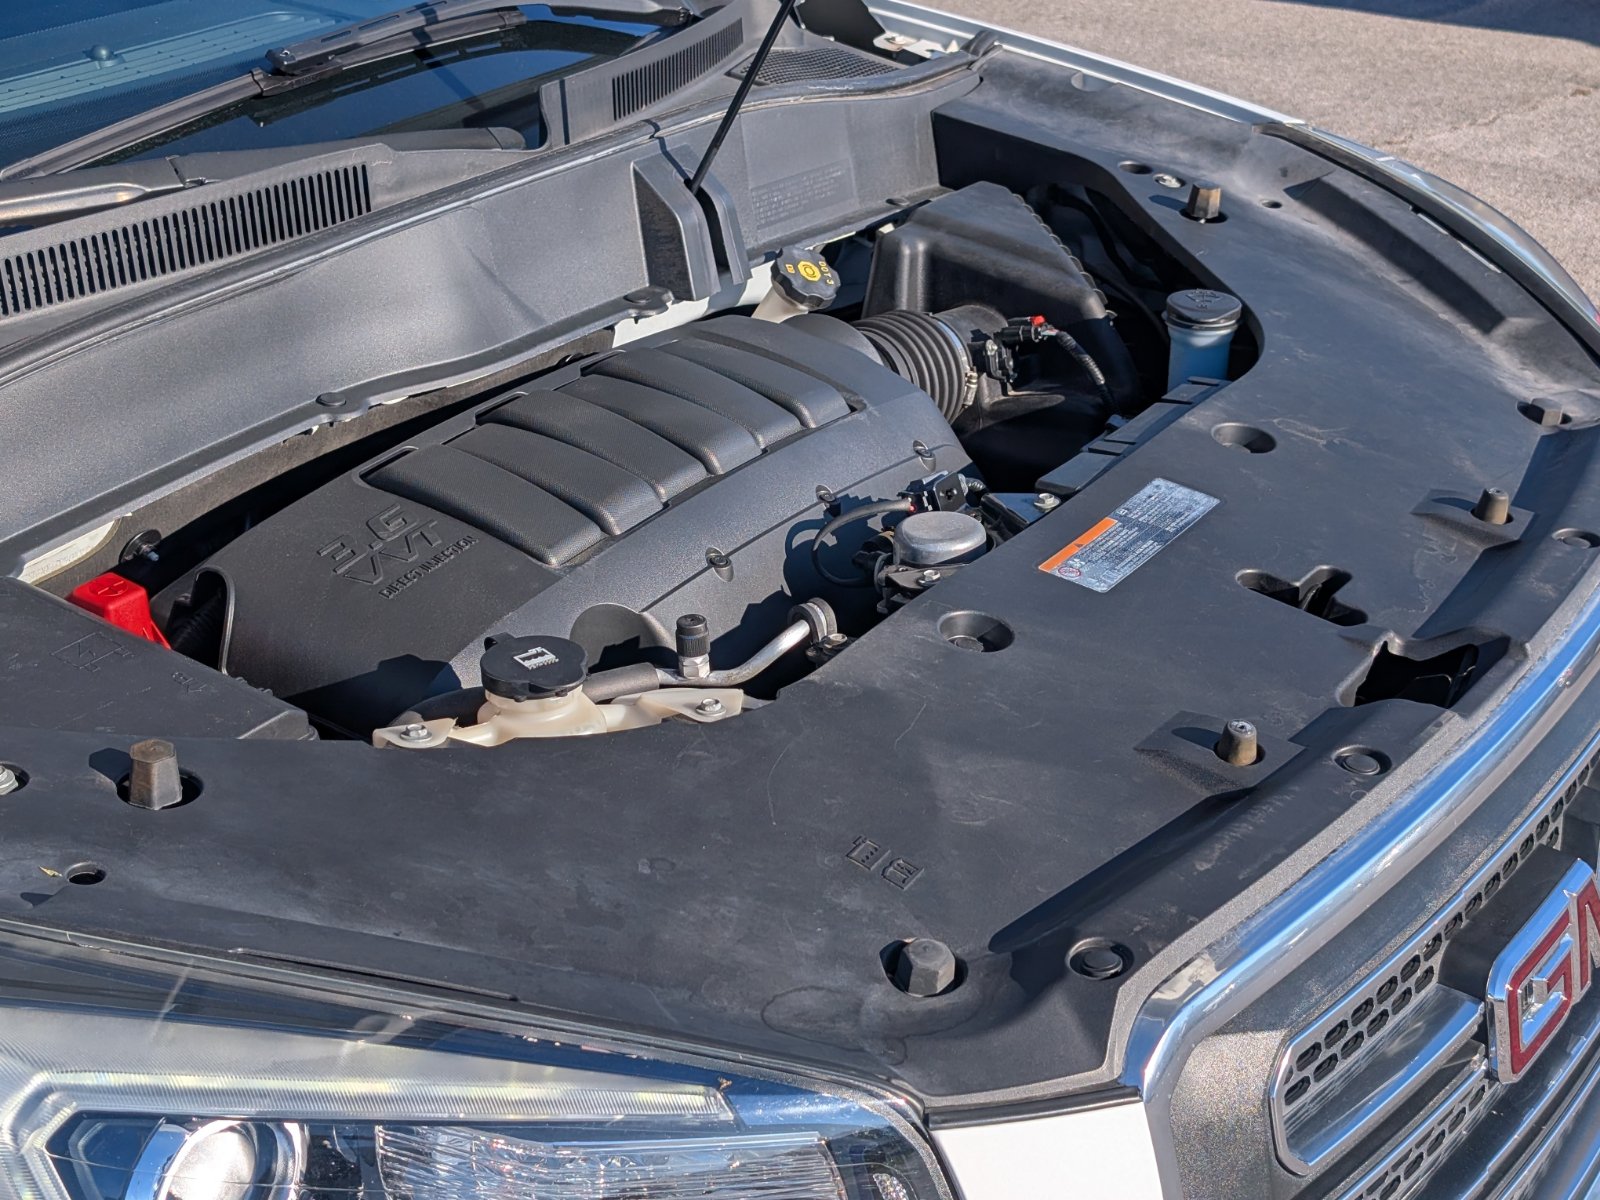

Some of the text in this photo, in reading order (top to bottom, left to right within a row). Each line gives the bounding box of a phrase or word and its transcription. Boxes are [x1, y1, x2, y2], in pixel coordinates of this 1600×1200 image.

[818, 261, 832, 278] DOT
[317, 502, 420, 575] 3.6
[343, 519, 442, 585] VVT
[378, 535, 480, 600] DIRECT INJECTION
